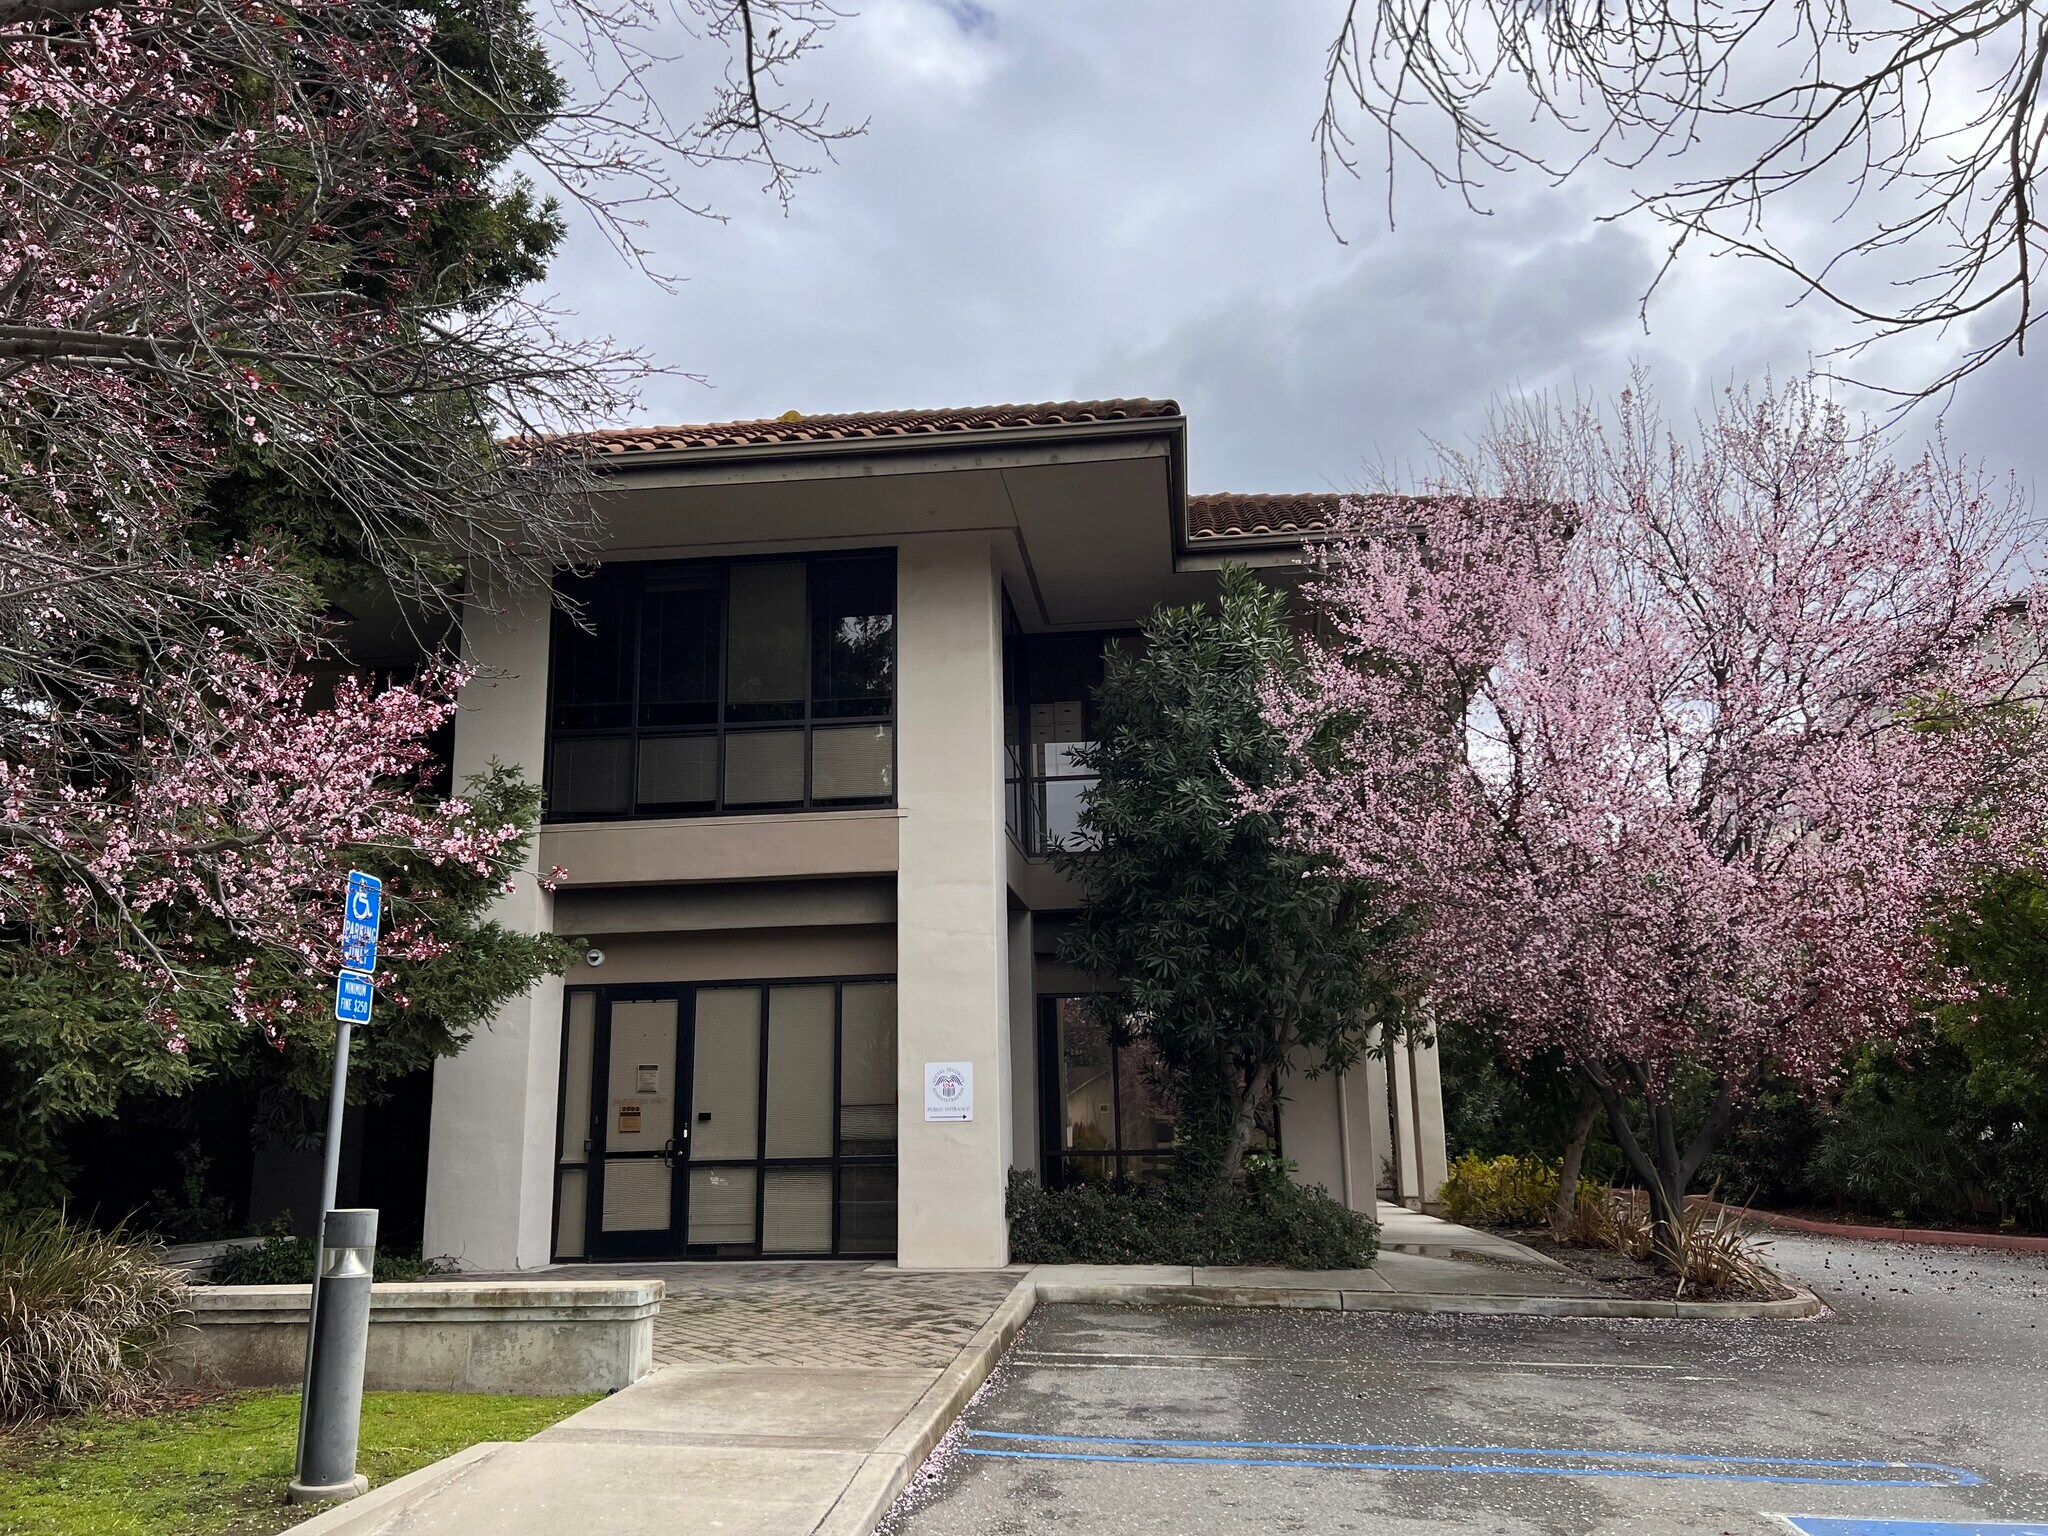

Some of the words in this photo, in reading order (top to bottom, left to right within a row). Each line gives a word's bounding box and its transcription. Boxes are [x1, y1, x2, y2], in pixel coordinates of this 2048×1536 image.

[345, 981, 366, 997] MINIMUM
[341, 998, 351, 1011] FINE
[354, 999, 367, 1013] $250
